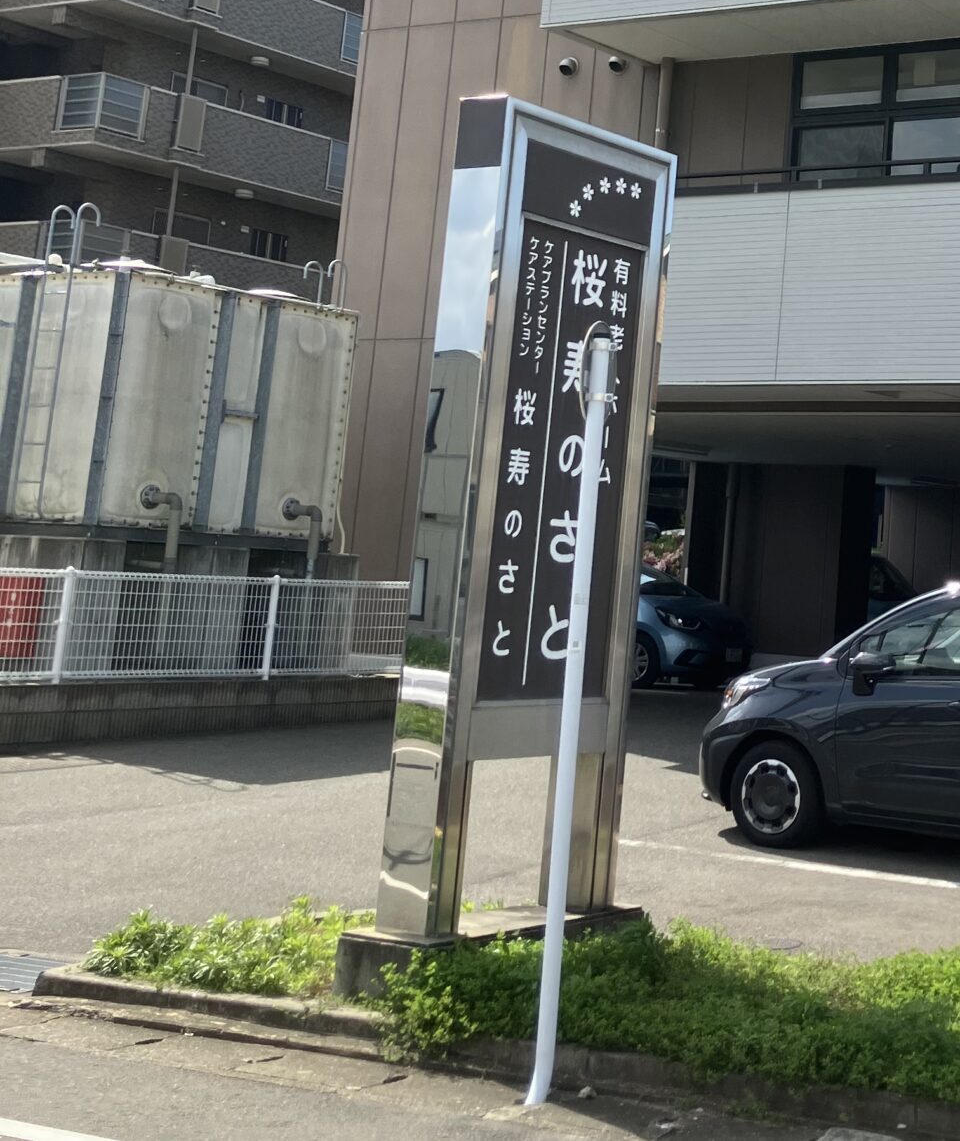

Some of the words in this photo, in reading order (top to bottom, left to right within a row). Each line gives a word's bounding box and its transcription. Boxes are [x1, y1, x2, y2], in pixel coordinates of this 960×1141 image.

[492, 388, 538, 656] 桜寿のさと
